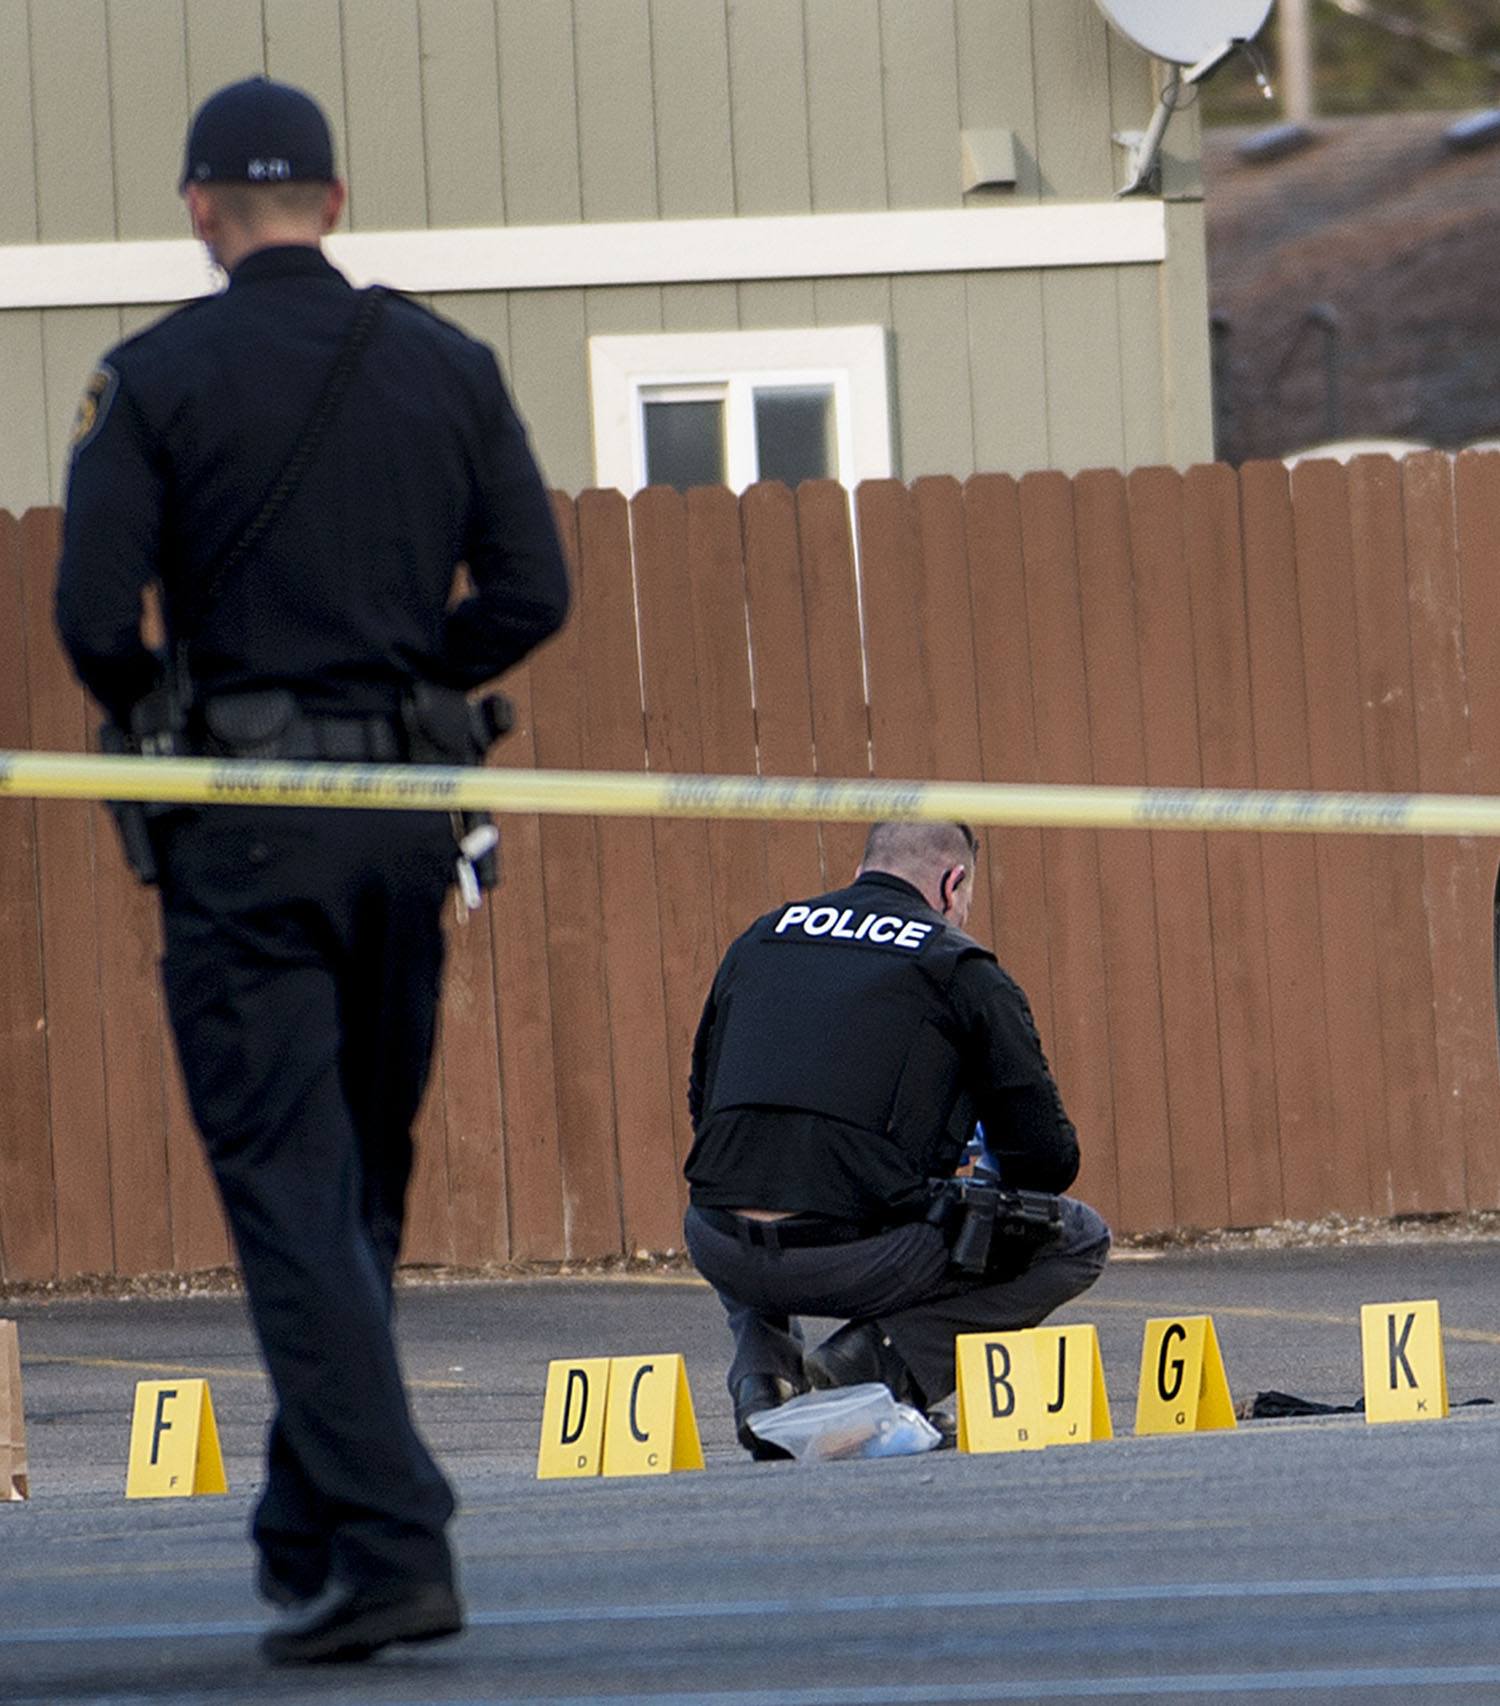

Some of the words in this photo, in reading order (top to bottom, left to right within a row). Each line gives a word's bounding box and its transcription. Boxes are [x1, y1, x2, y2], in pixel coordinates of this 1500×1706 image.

[774, 905, 933, 949] POLICE
[1157, 1323, 1187, 1402] G
[1387, 1313, 1419, 1390] K
[984, 1342, 1016, 1418] B
[1047, 1336, 1067, 1413] J
[560, 1369, 589, 1445] D
[629, 1364, 655, 1442] C
[1175, 1411, 1186, 1425] G
[1416, 1400, 1428, 1412] K
[150, 1389, 178, 1465] F
[1017, 1428, 1029, 1442] B
[1068, 1423, 1078, 1437] J
[169, 1475, 179, 1489] F
[577, 1455, 588, 1469] D
[647, 1453, 658, 1467] C
